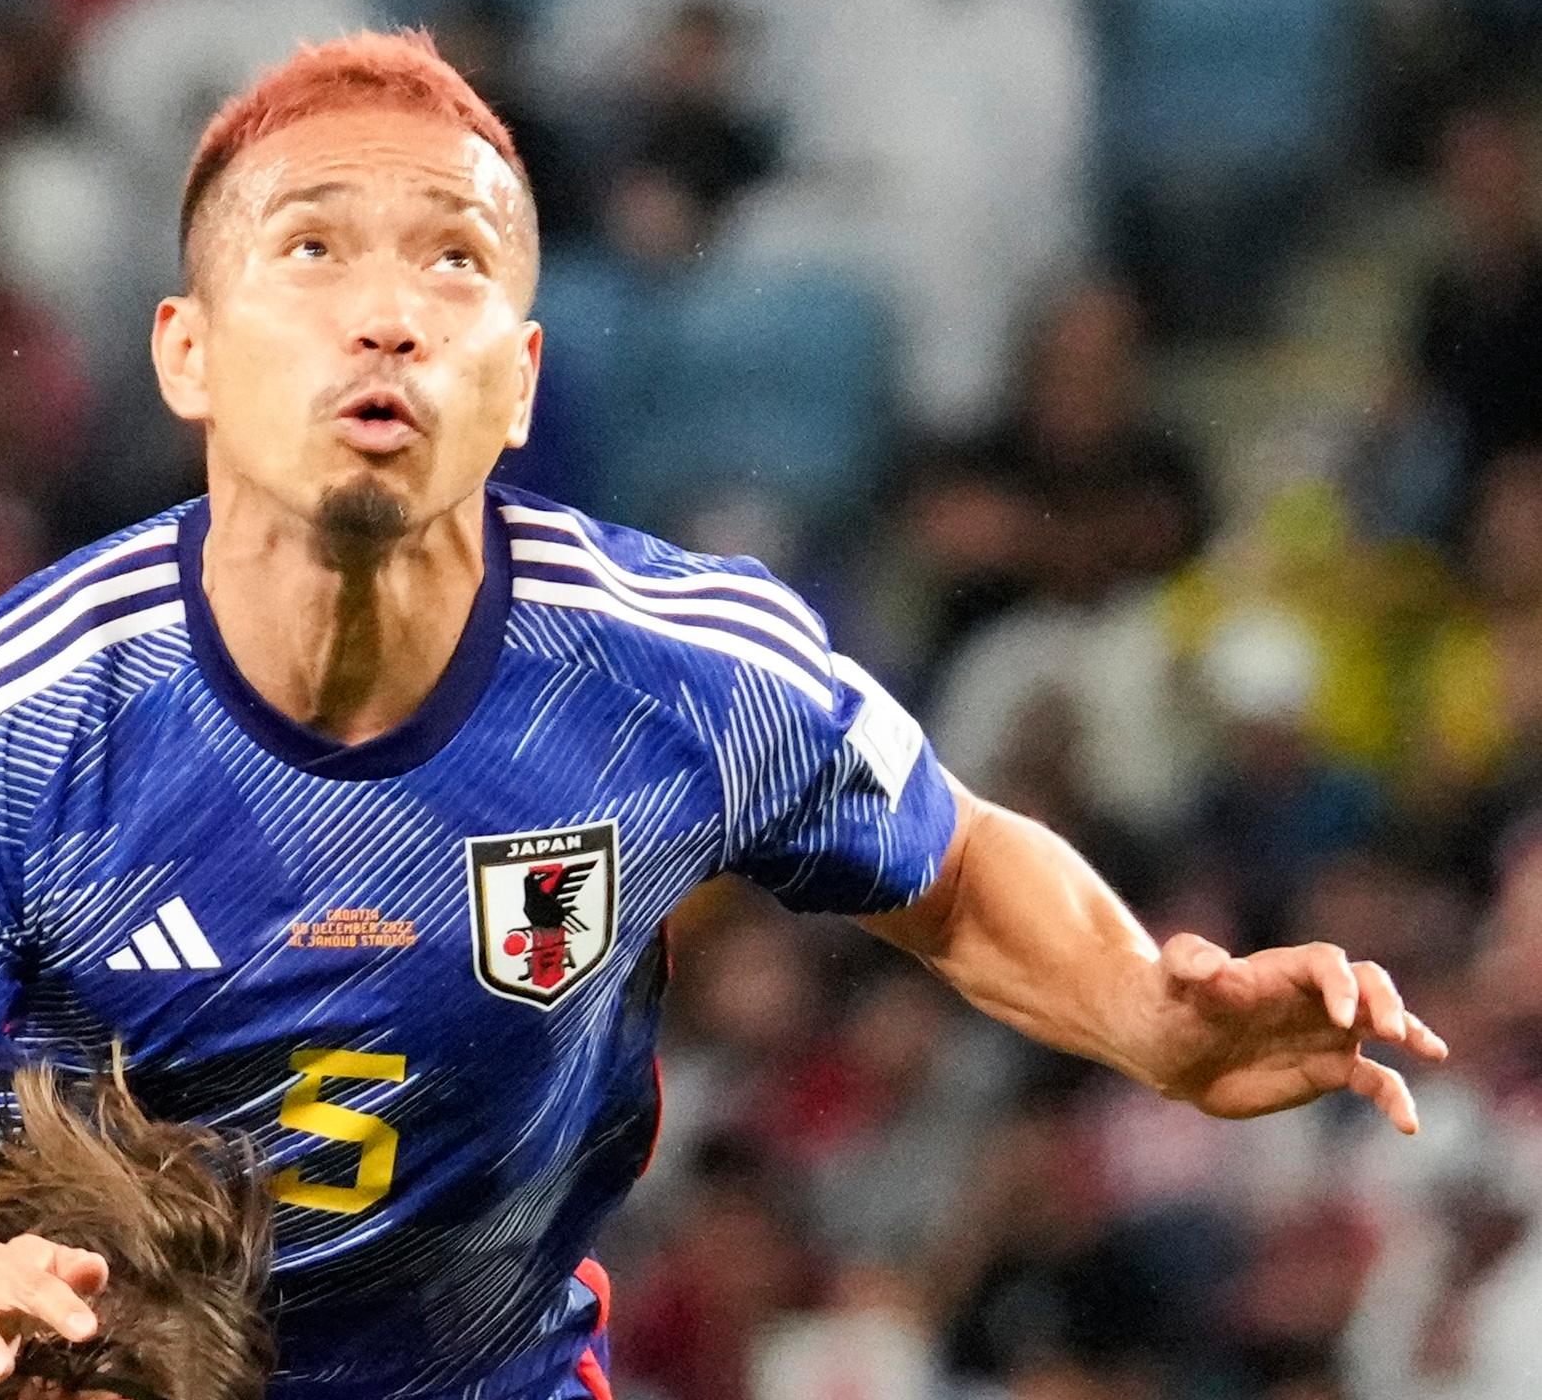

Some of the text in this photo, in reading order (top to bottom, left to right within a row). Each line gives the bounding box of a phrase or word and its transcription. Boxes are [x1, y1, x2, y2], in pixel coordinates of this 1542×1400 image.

[506, 835, 582, 858] JAPAN
[326, 908, 380, 921] CROATIA
[312, 921, 378, 935] DECEMBER
[266, 1048, 407, 1214] 5
